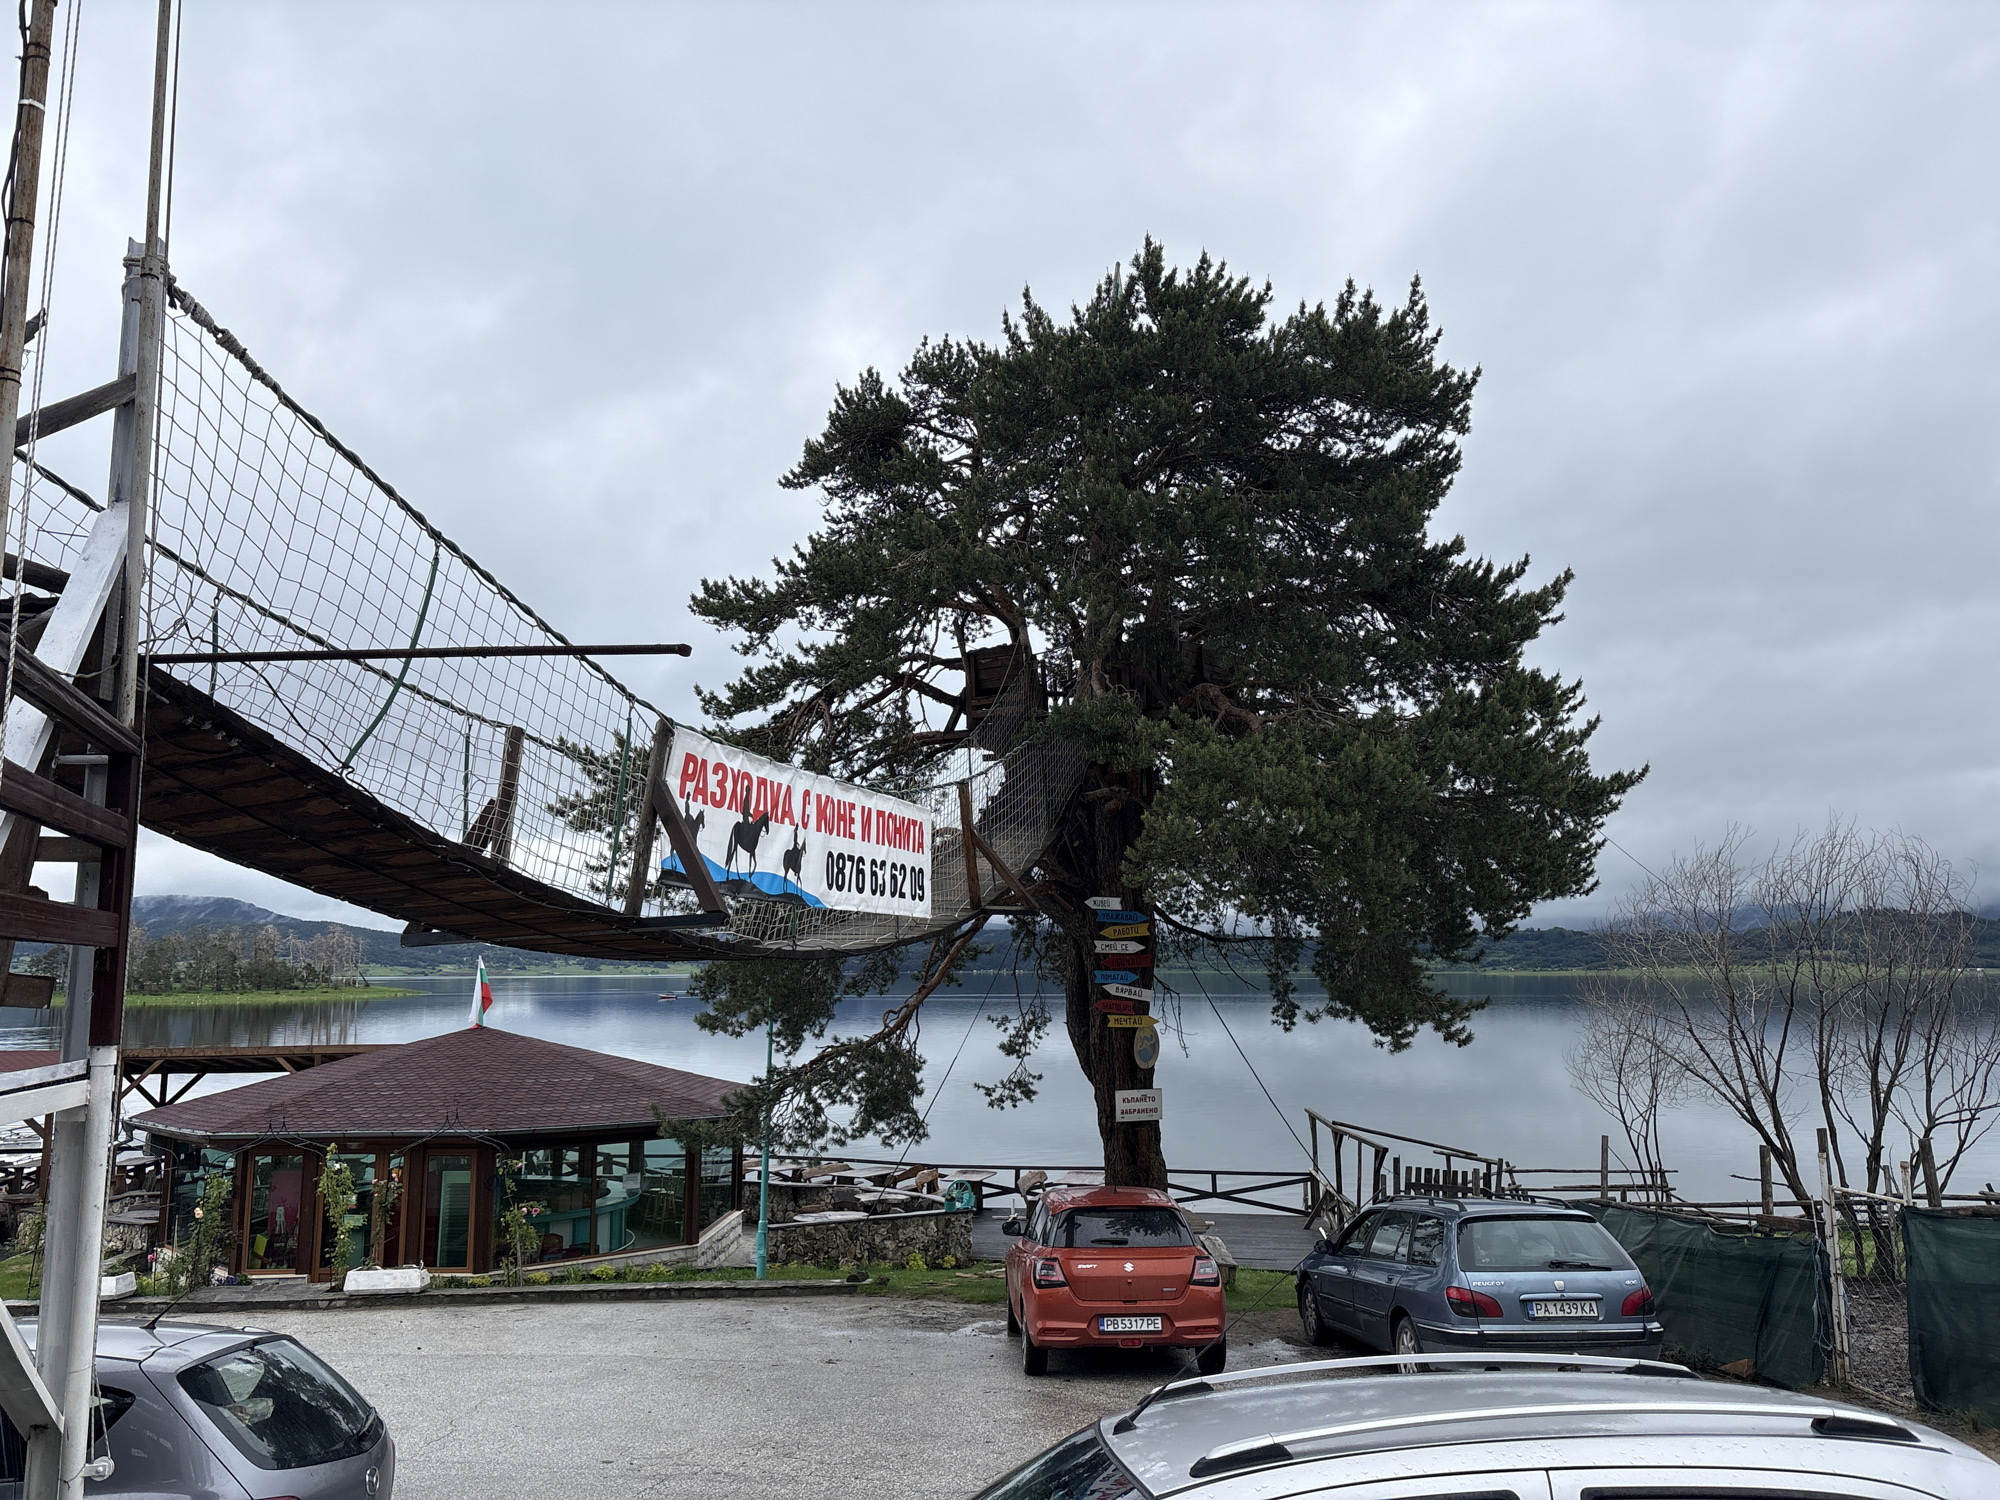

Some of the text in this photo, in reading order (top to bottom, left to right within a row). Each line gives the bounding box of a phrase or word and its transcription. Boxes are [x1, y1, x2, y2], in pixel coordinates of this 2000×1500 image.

[679, 752, 925, 855] РАЗХОДКА С КОНЕ И ПОНИТА
[826, 850, 925, 902] 0876 63 62 09
[1113, 927, 1140, 936] РАБОТИ
[1100, 943, 1129, 951] СМЕЙ СЕ
[1100, 972, 1129, 981] ПОМАГАЙ
[1115, 986, 1143, 998] ВЯРВАЙ
[1114, 1016, 1143, 1026] МЕЧТАЙ
[1122, 1095, 1156, 1104] КЪПАНЕТО
